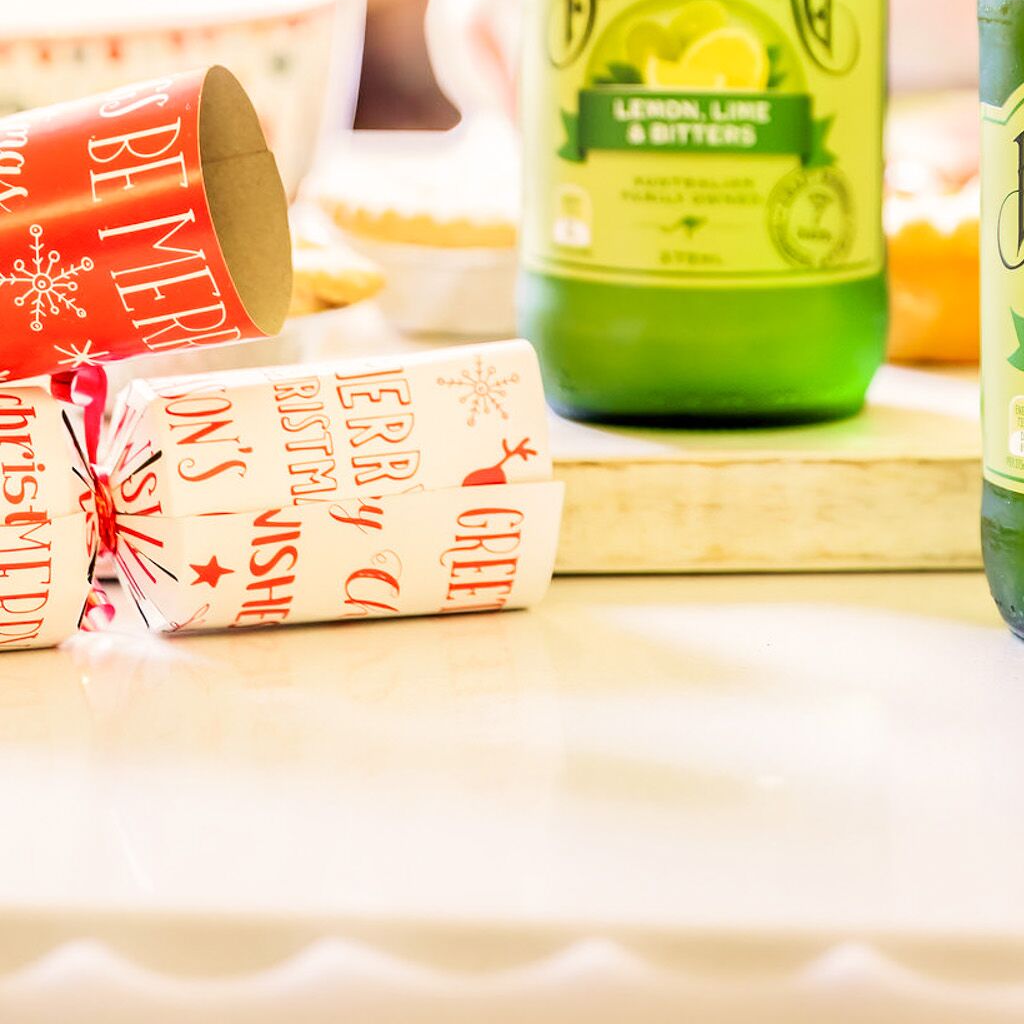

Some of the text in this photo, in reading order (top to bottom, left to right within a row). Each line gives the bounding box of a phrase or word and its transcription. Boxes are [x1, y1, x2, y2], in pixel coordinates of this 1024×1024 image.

[709, 100, 772, 124] LIME
[650, 124, 758, 147] BITTERS
[88, 117, 189, 203] BE
